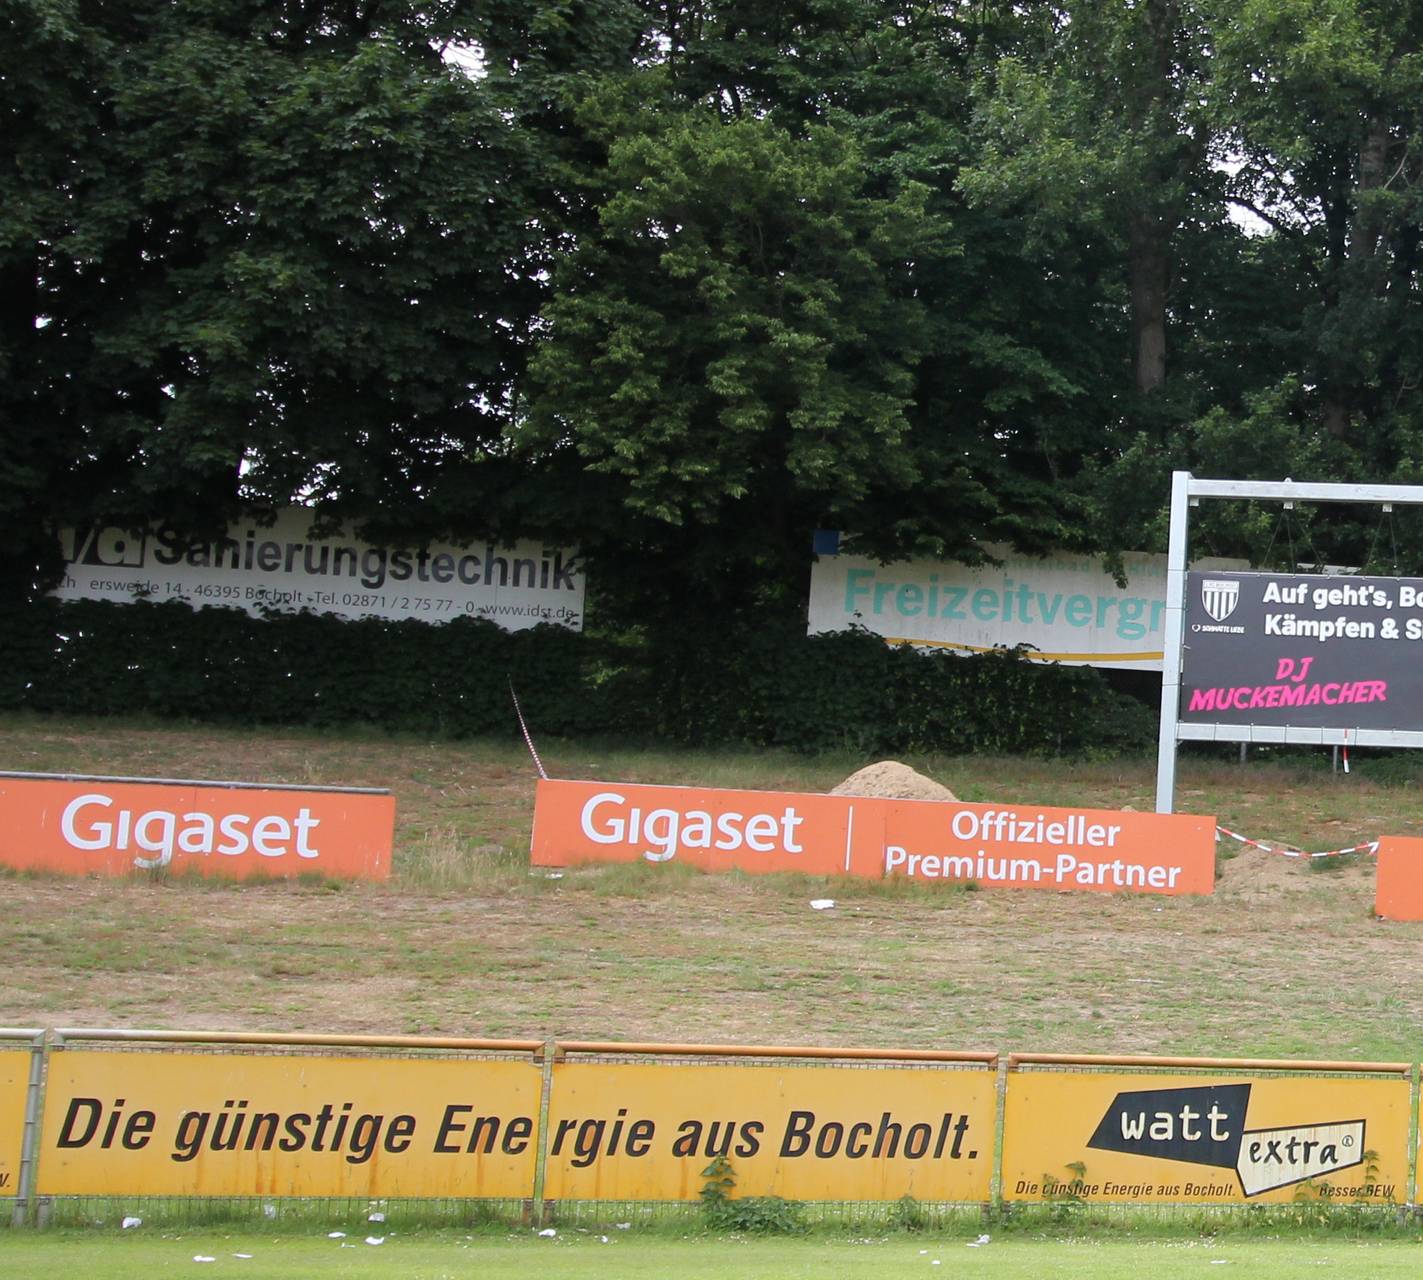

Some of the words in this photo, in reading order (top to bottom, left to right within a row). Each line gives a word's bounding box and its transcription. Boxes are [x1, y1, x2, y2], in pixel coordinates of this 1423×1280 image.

[154, 524, 575, 590] Sanierungstechnik
[165, 582, 182, 594] 14
[194, 585, 240, 599] 46395
[245, 586, 302, 603] Bocholt
[342, 592, 386, 607] 02871
[1263, 582, 1308, 606] Auf
[1312, 584, 1394, 611] geht's,
[1264, 613, 1375, 643] Kämpfen
[1380, 619, 1400, 640] &
[1275, 657, 1314, 682] DJ
[1188, 680, 1388, 712] MUCKEMACHER
[60, 793, 320, 870] Gigaset
[580, 793, 804, 862] Gigaset
[951, 810, 1121, 848] Offizieller
[885, 846, 1182, 890] Premium-Partner
[57, 1096, 155, 1149] Die
[171, 1098, 417, 1163] günstige
[673, 1118, 765, 1159] aus
[780, 1110, 980, 1160] Bocholt.
[1120, 1103, 1231, 1143] watt
[1015, 1181, 1038, 1195] Die
[1103, 1182, 1153, 1199] Energie
[1157, 1185, 1180, 1196] aus
[1184, 1183, 1236, 1197] Bocholt.
